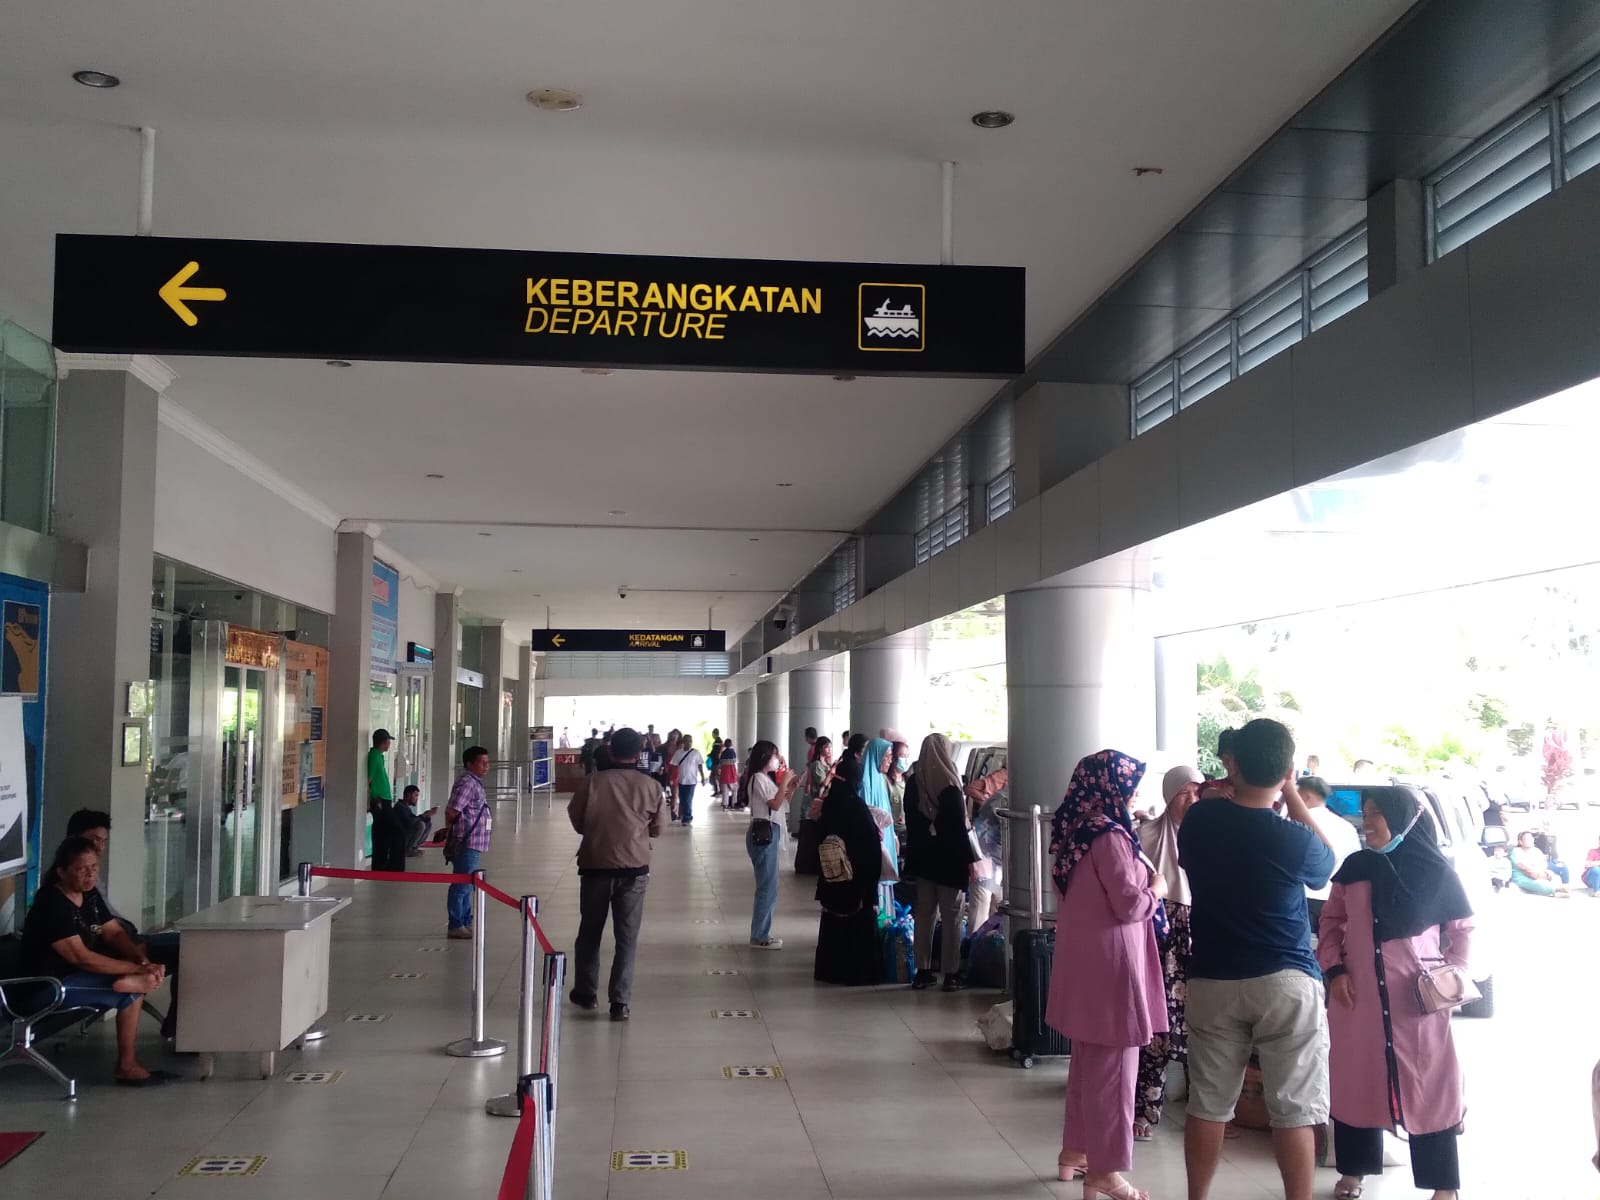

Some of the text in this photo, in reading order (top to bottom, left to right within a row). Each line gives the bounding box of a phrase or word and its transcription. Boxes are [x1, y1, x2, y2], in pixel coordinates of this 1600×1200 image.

[525, 278, 821, 314] KEBERANGKATAN
[524, 307, 729, 339] DEPARTURE
[629, 634, 684, 642] KEDATANGAN
